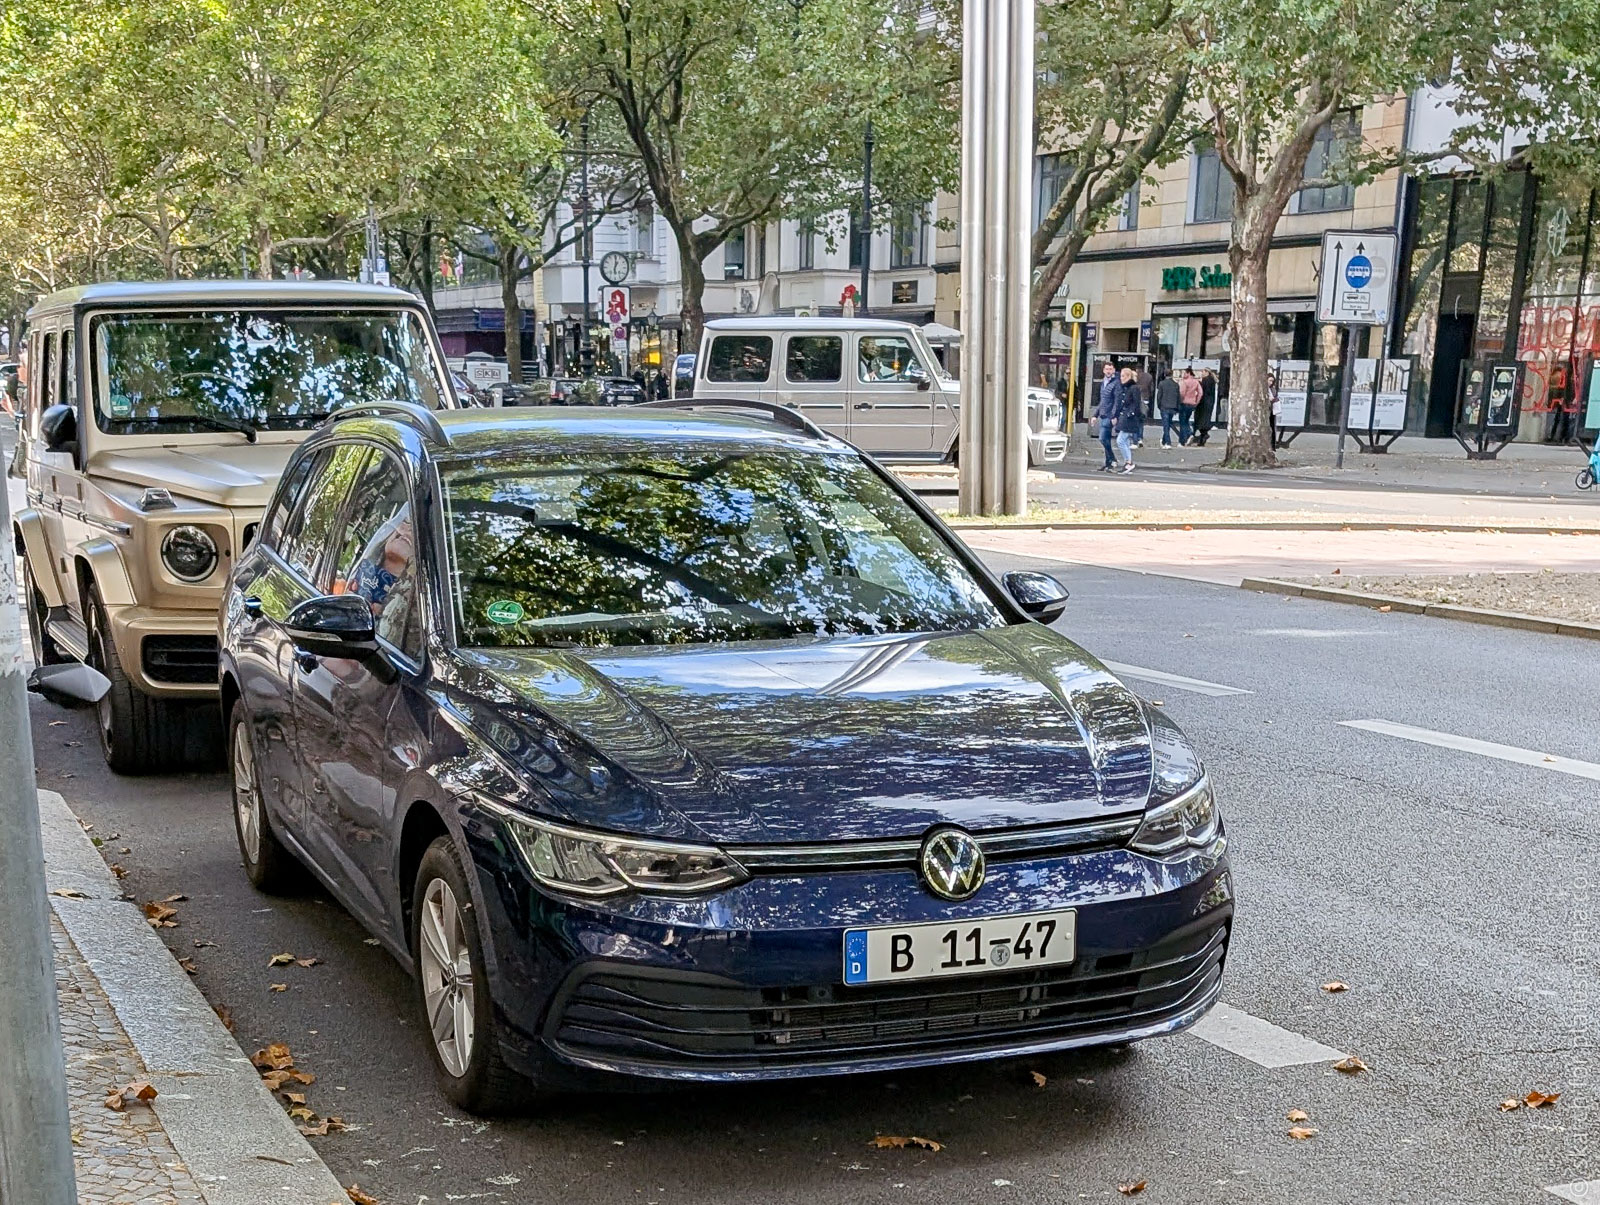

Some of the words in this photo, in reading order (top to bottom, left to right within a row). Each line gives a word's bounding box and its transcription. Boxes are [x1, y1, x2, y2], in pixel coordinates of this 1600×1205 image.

[1199, 264, 1232, 288] Schu
[852, 961, 861, 974] D
[890, 934, 914, 973] B
